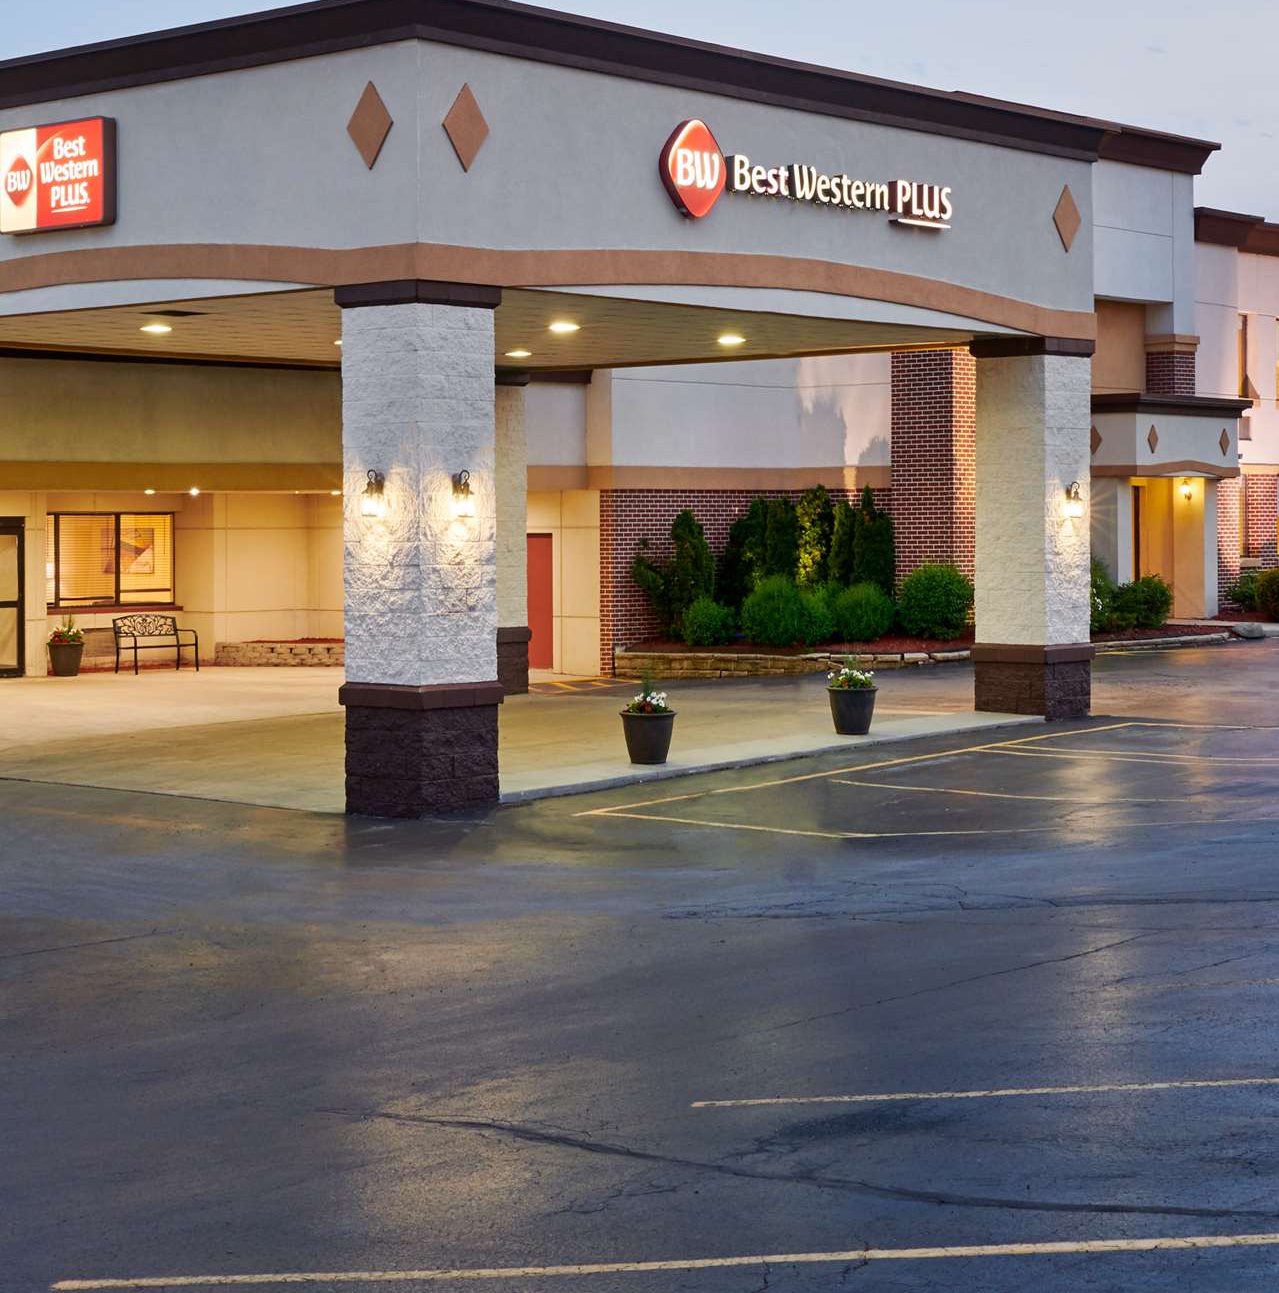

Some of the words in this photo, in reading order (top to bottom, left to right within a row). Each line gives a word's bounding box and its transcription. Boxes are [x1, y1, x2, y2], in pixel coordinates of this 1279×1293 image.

[53, 135, 86, 159] Best
[6, 169, 31, 192] BW
[40, 159, 99, 184] Western
[675, 149, 719, 189] BW
[734, 155, 789, 196] Best
[793, 164, 890, 210] Western
[897, 179, 953, 220] PLUS
